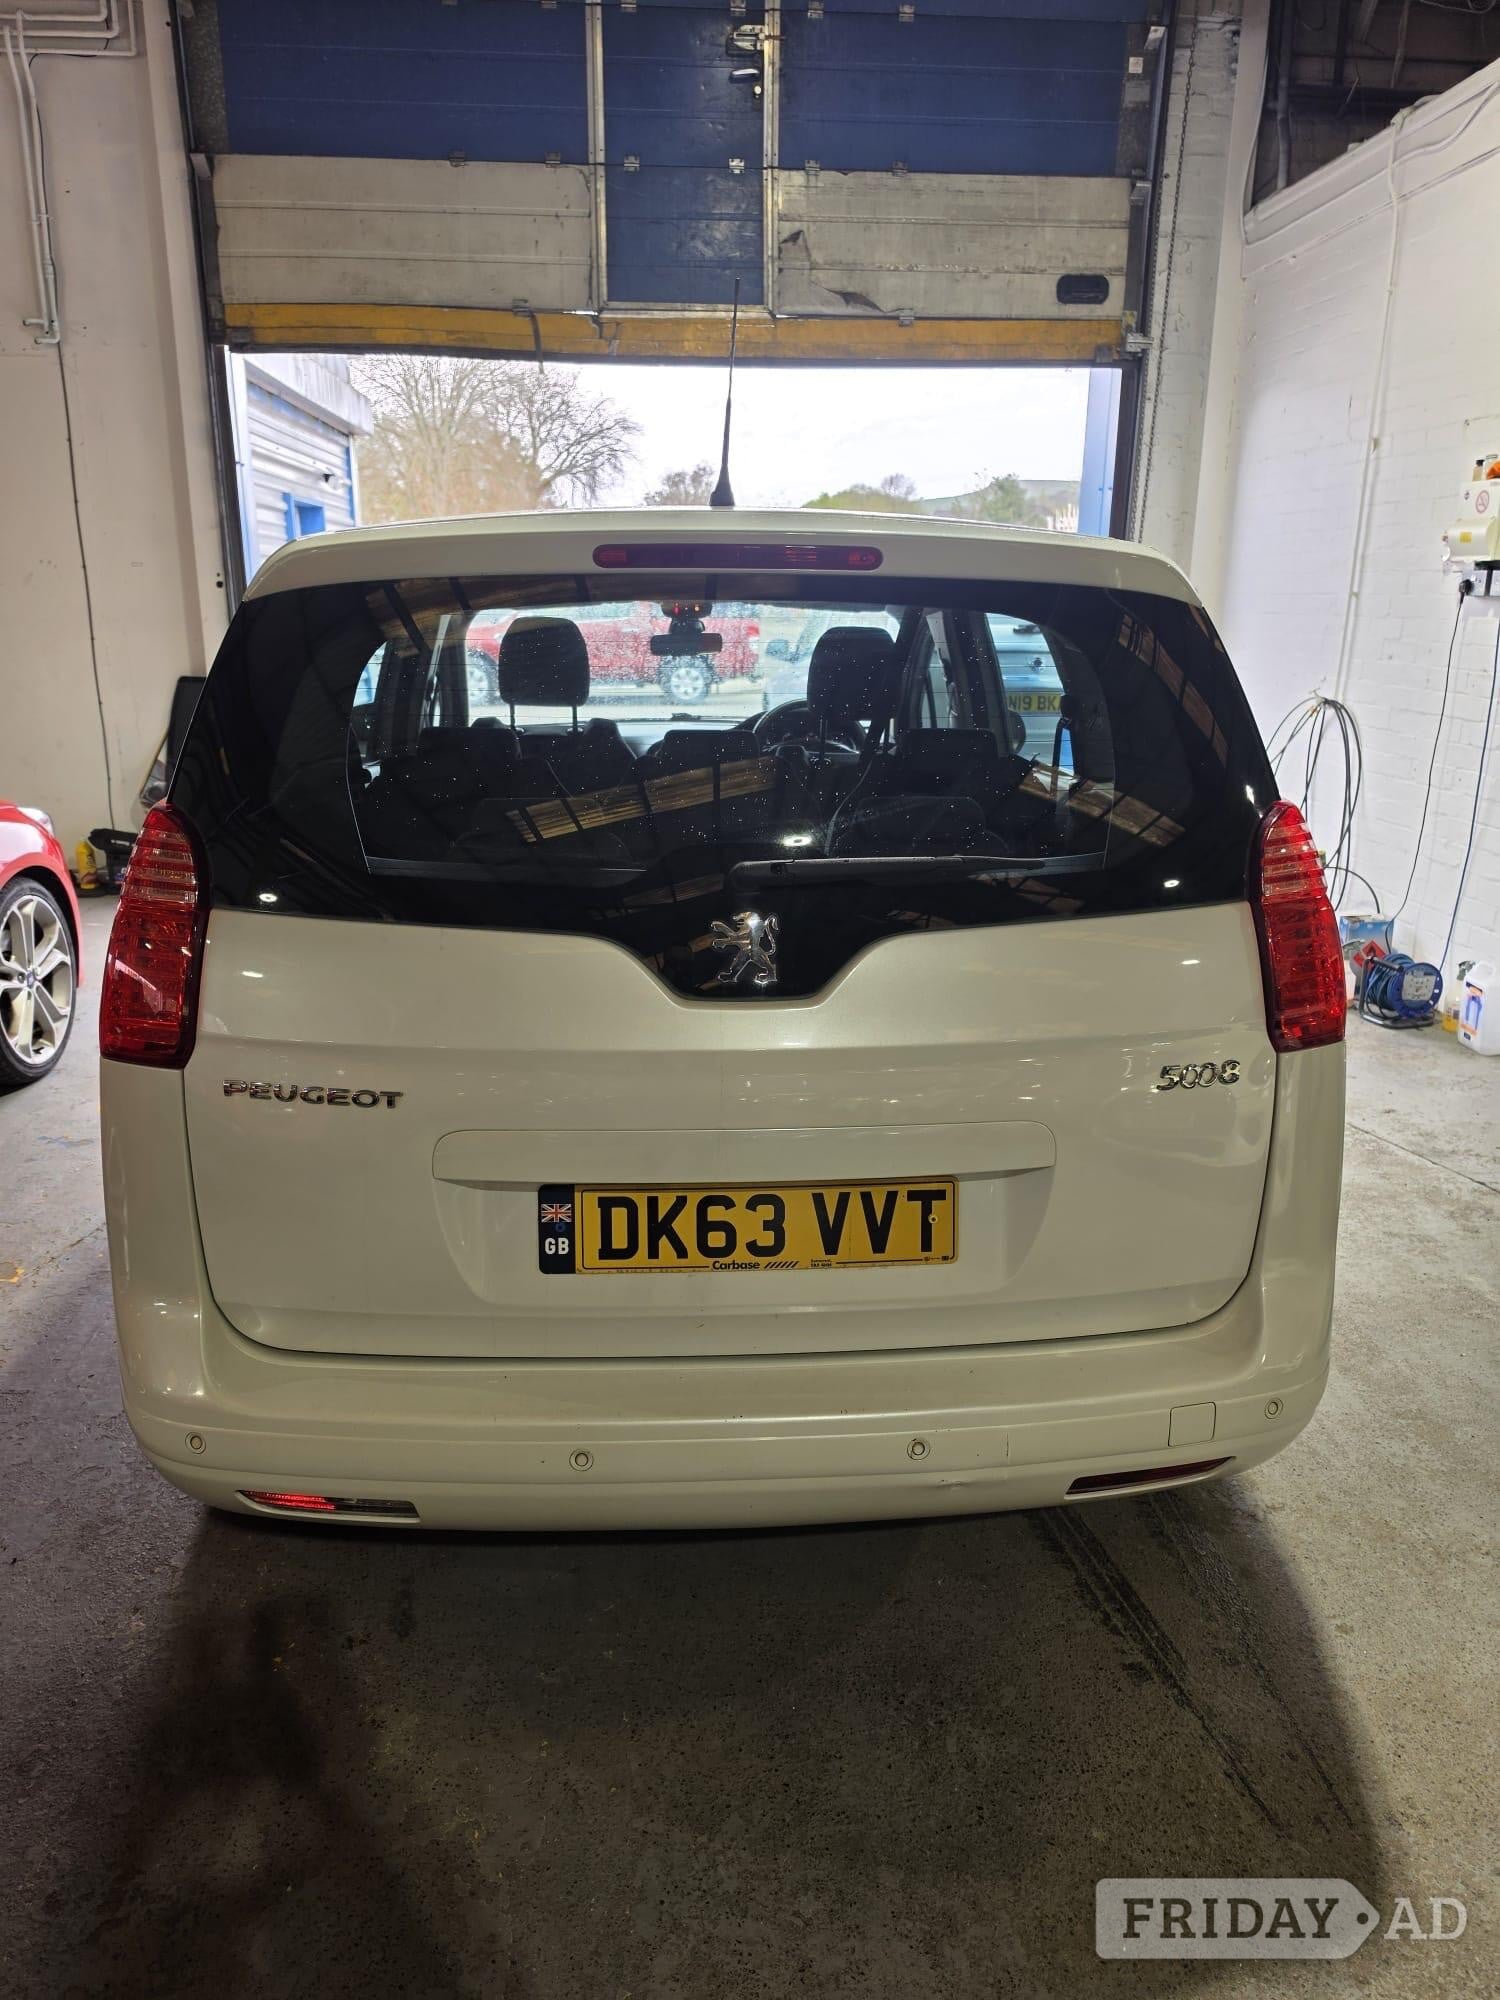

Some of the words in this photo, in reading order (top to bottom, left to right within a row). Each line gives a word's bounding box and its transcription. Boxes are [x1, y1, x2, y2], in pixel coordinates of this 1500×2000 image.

[1037, 695, 1062, 711] BK
[1156, 1059, 1241, 1090] 5008
[222, 1079, 404, 1109] PEUGEOT
[597, 1193, 786, 1261] DK63
[811, 1189, 947, 1256] VVT
[543, 1237, 569, 1256] GB
[711, 1260, 761, 1271] Carbase
